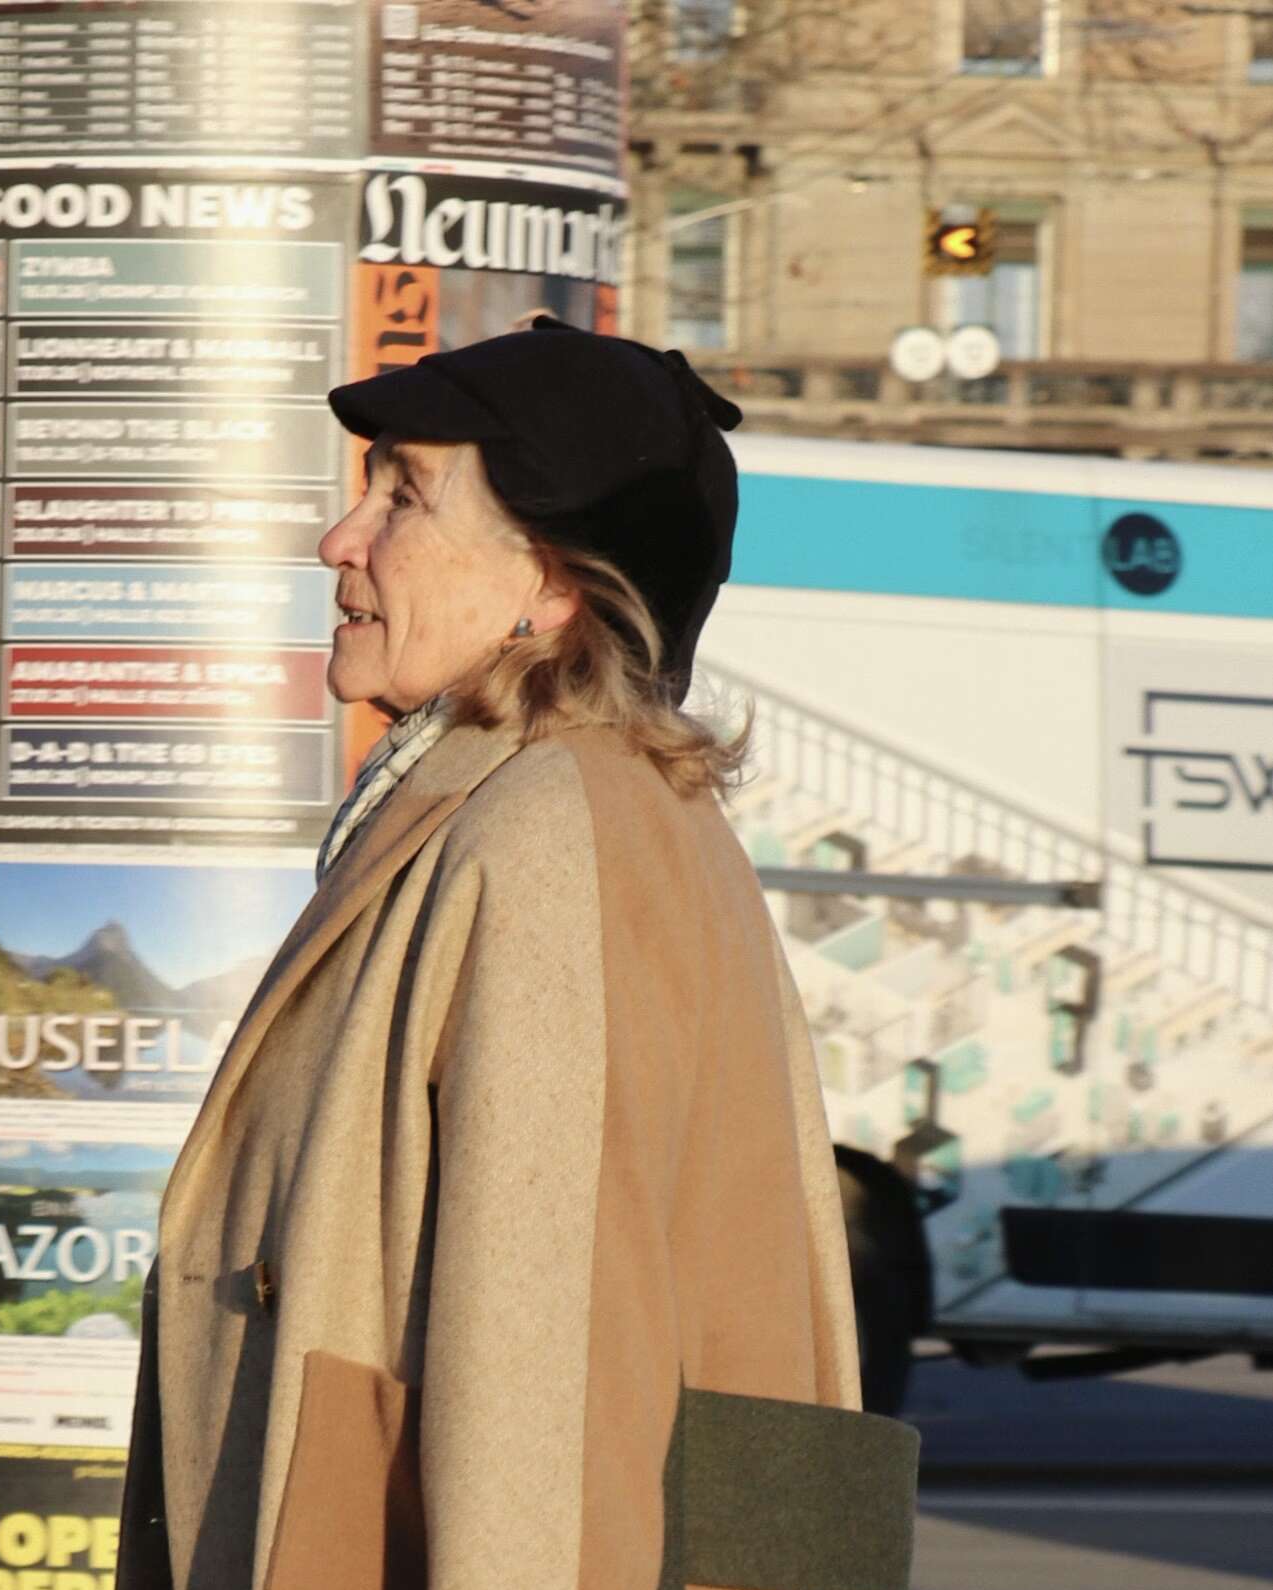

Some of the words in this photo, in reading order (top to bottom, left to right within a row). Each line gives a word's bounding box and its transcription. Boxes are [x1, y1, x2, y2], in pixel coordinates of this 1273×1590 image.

[140, 184, 315, 231] NEWS
[18, 338, 168, 360] LIONHEART
[173, 339, 191, 359] &
[15, 418, 124, 440] BEYOND
[126, 419, 179, 440] THE
[14, 500, 171, 522] SLAUGHTER
[173, 500, 210, 521] TO
[12, 580, 123, 602] MARCUS
[126, 581, 145, 601] &
[12, 661, 180, 684] AMARANTHE
[182, 662, 202, 683] &
[11, 741, 90, 764] D-A-D
[91, 742, 113, 763] &
[115, 742, 169, 763] THE
